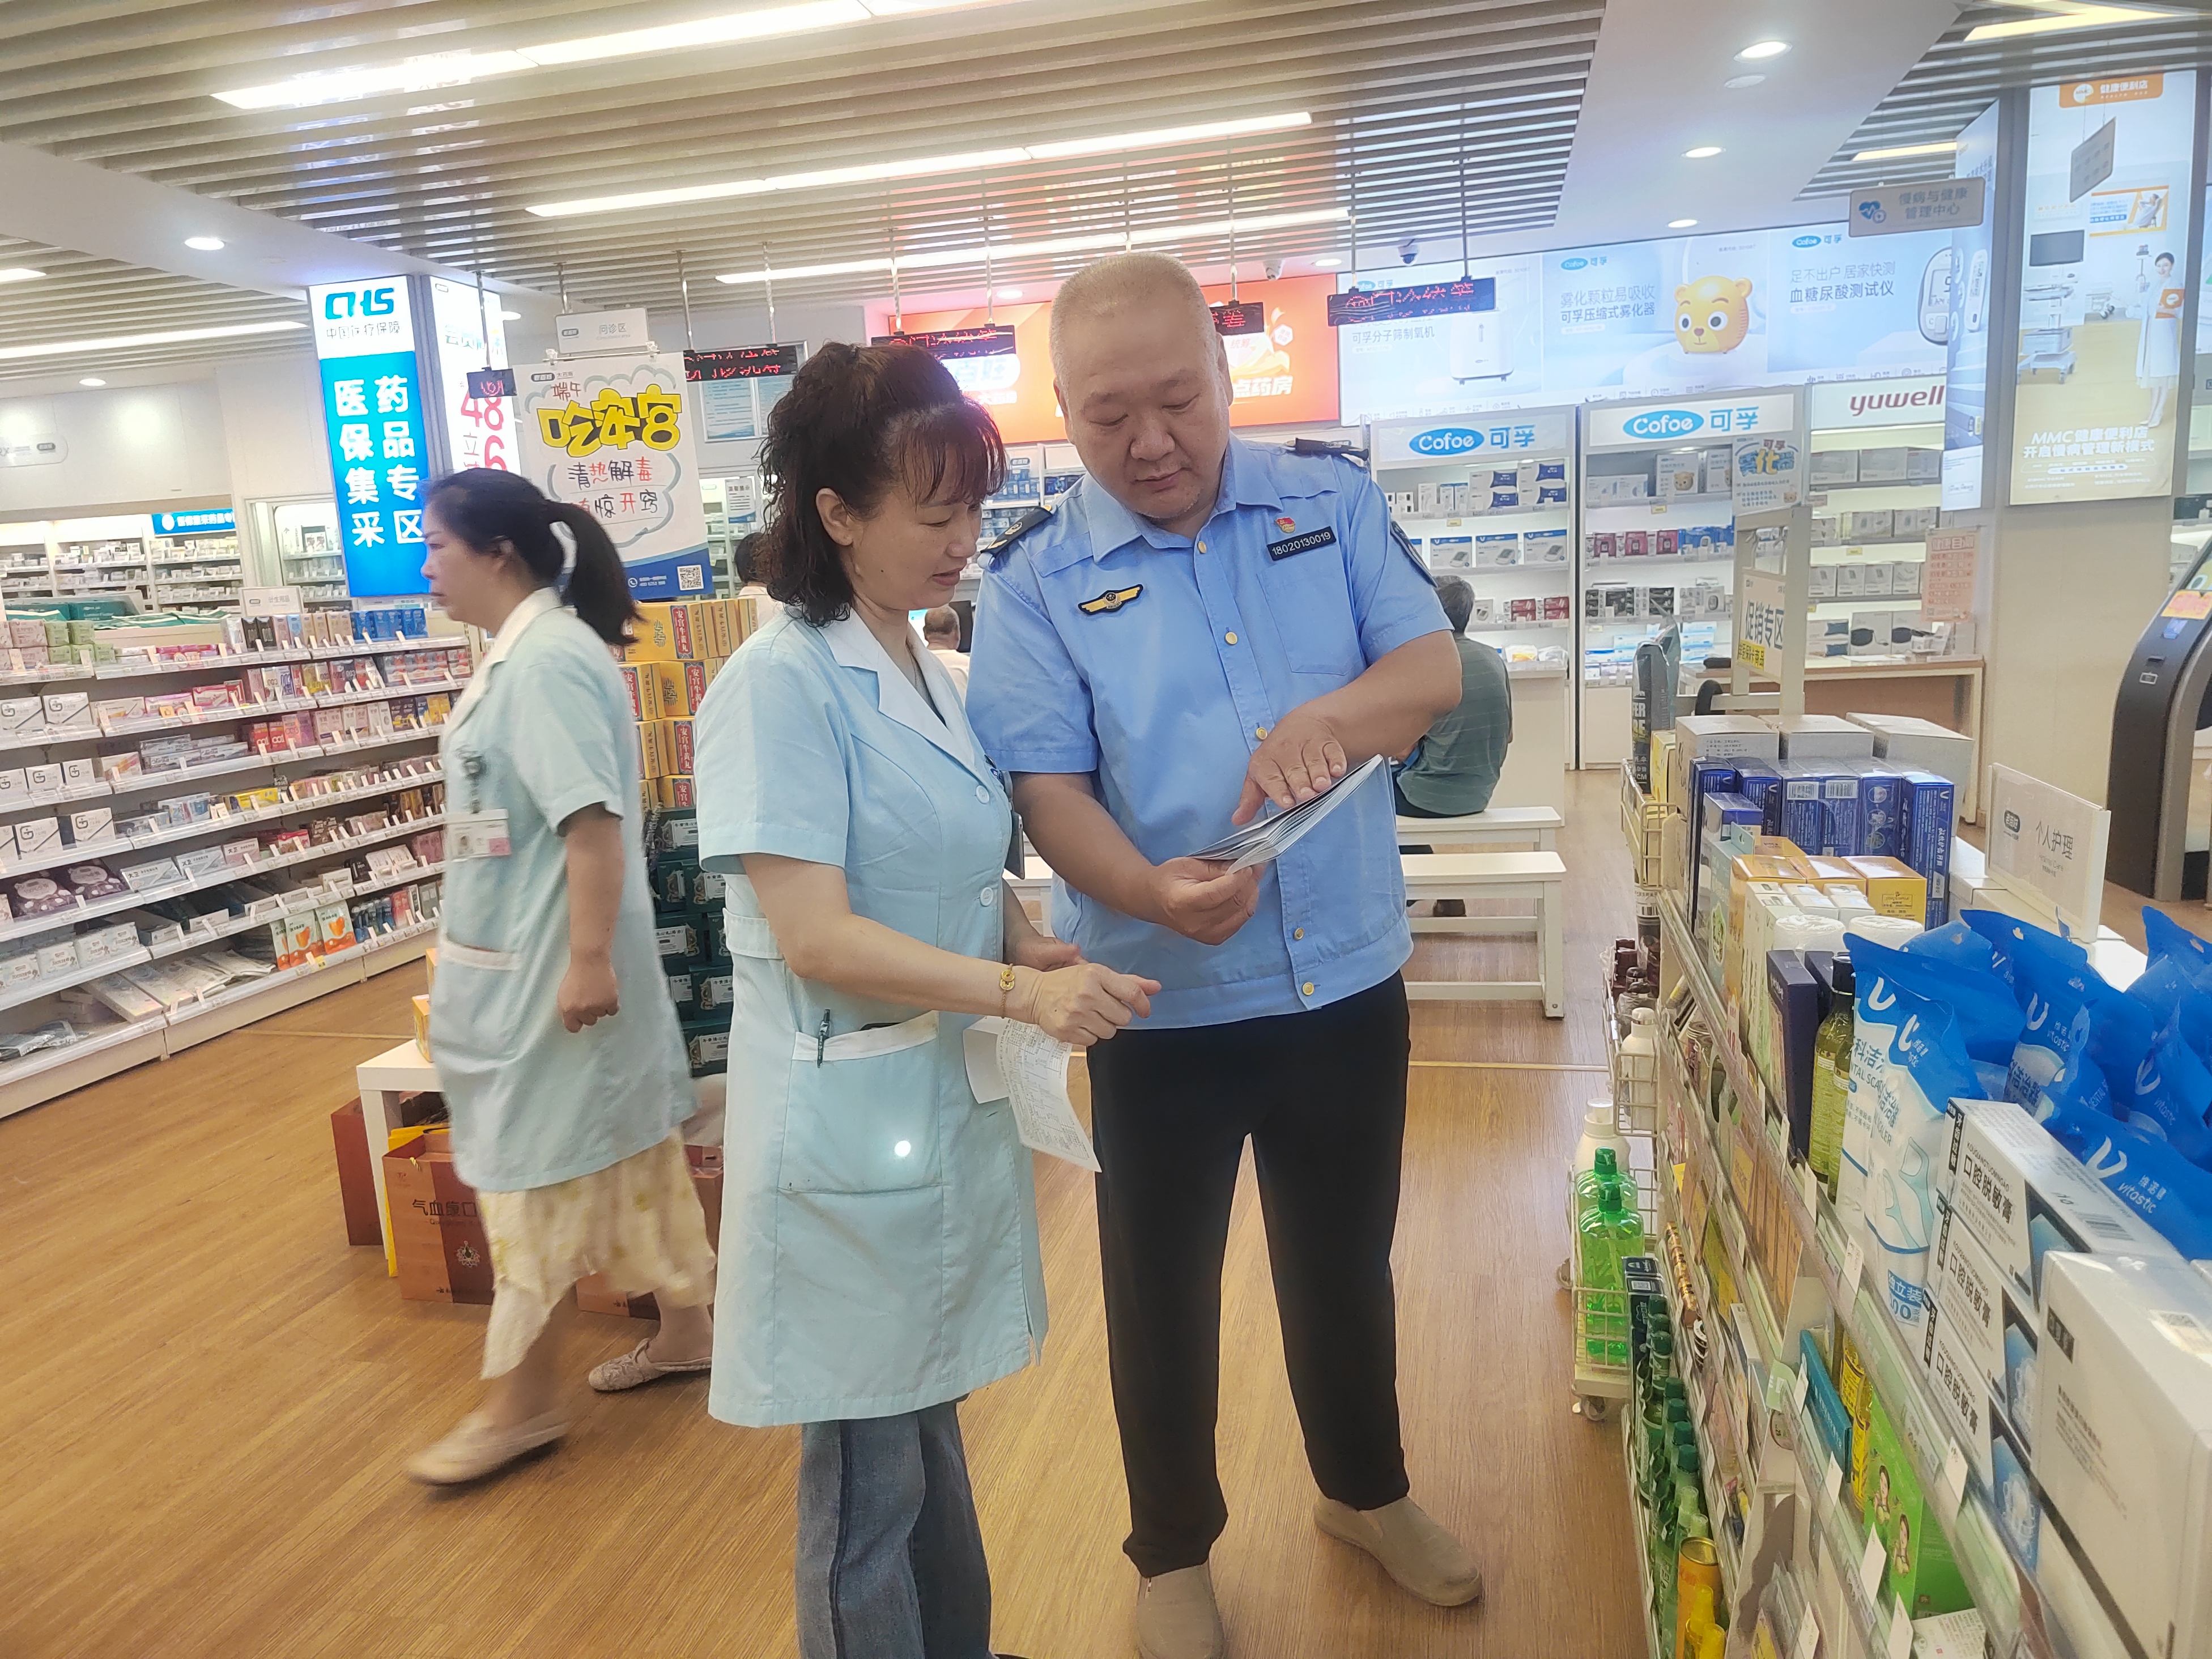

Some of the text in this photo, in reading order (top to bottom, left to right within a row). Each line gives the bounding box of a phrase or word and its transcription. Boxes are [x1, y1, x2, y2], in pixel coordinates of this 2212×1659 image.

[1899, 187, 1968, 206] 慢病与健康
[1905, 202, 1960, 219] 管理中心
[1790, 261, 1895, 284] 足不出户 居家快测
[1560, 284, 1656, 308] 雾化颗粒易吸收
[1789, 280, 1894, 304] 血糖尿酸测试仪
[1561, 302, 1656, 324] 可孚压缩式雾化器
[327, 321, 400, 339] 中国医疗保障
[599, 324, 626, 334] 问诊区
[551, 381, 581, 401] 端午
[1849, 385, 1945, 416] yuwell
[1633, 406, 1759, 434] Cofoe 可孚
[1418, 424, 1535, 451] Cofoe 可孚
[2023, 439, 2155, 459] 开启慢病管理新模式
[568, 456, 653, 490] 清热解毒
[1271, 531, 1331, 556] 18020130019
[1745, 599, 1784, 650] 促销专区
[2035, 821, 2074, 860] 个人护理
[1964, 1154, 2013, 1224] 口腔脱敏膏
[1950, 1252, 1991, 1329] 口腔脱敏膏
[1936, 1351, 1978, 1435] 口腔脱敏膏
